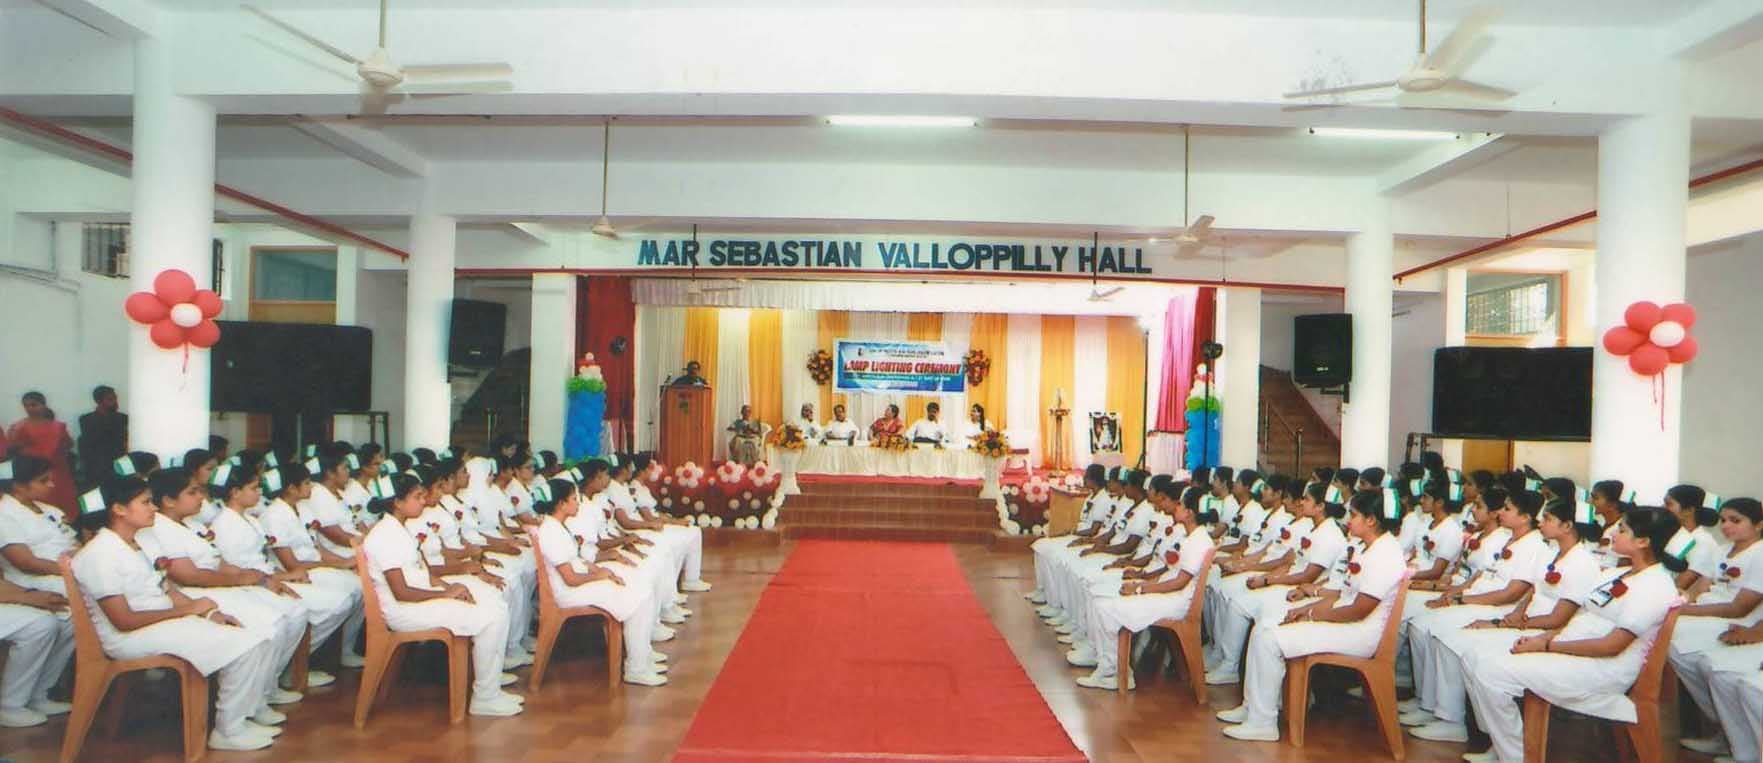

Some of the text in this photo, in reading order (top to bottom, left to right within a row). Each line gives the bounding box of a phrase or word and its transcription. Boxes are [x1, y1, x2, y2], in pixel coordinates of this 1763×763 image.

[638, 240, 1153, 273] MAR SEBASTIAN VALLOPPILLY HALL
[845, 360, 961, 374] LAMP LIGHTING CEREMONY
